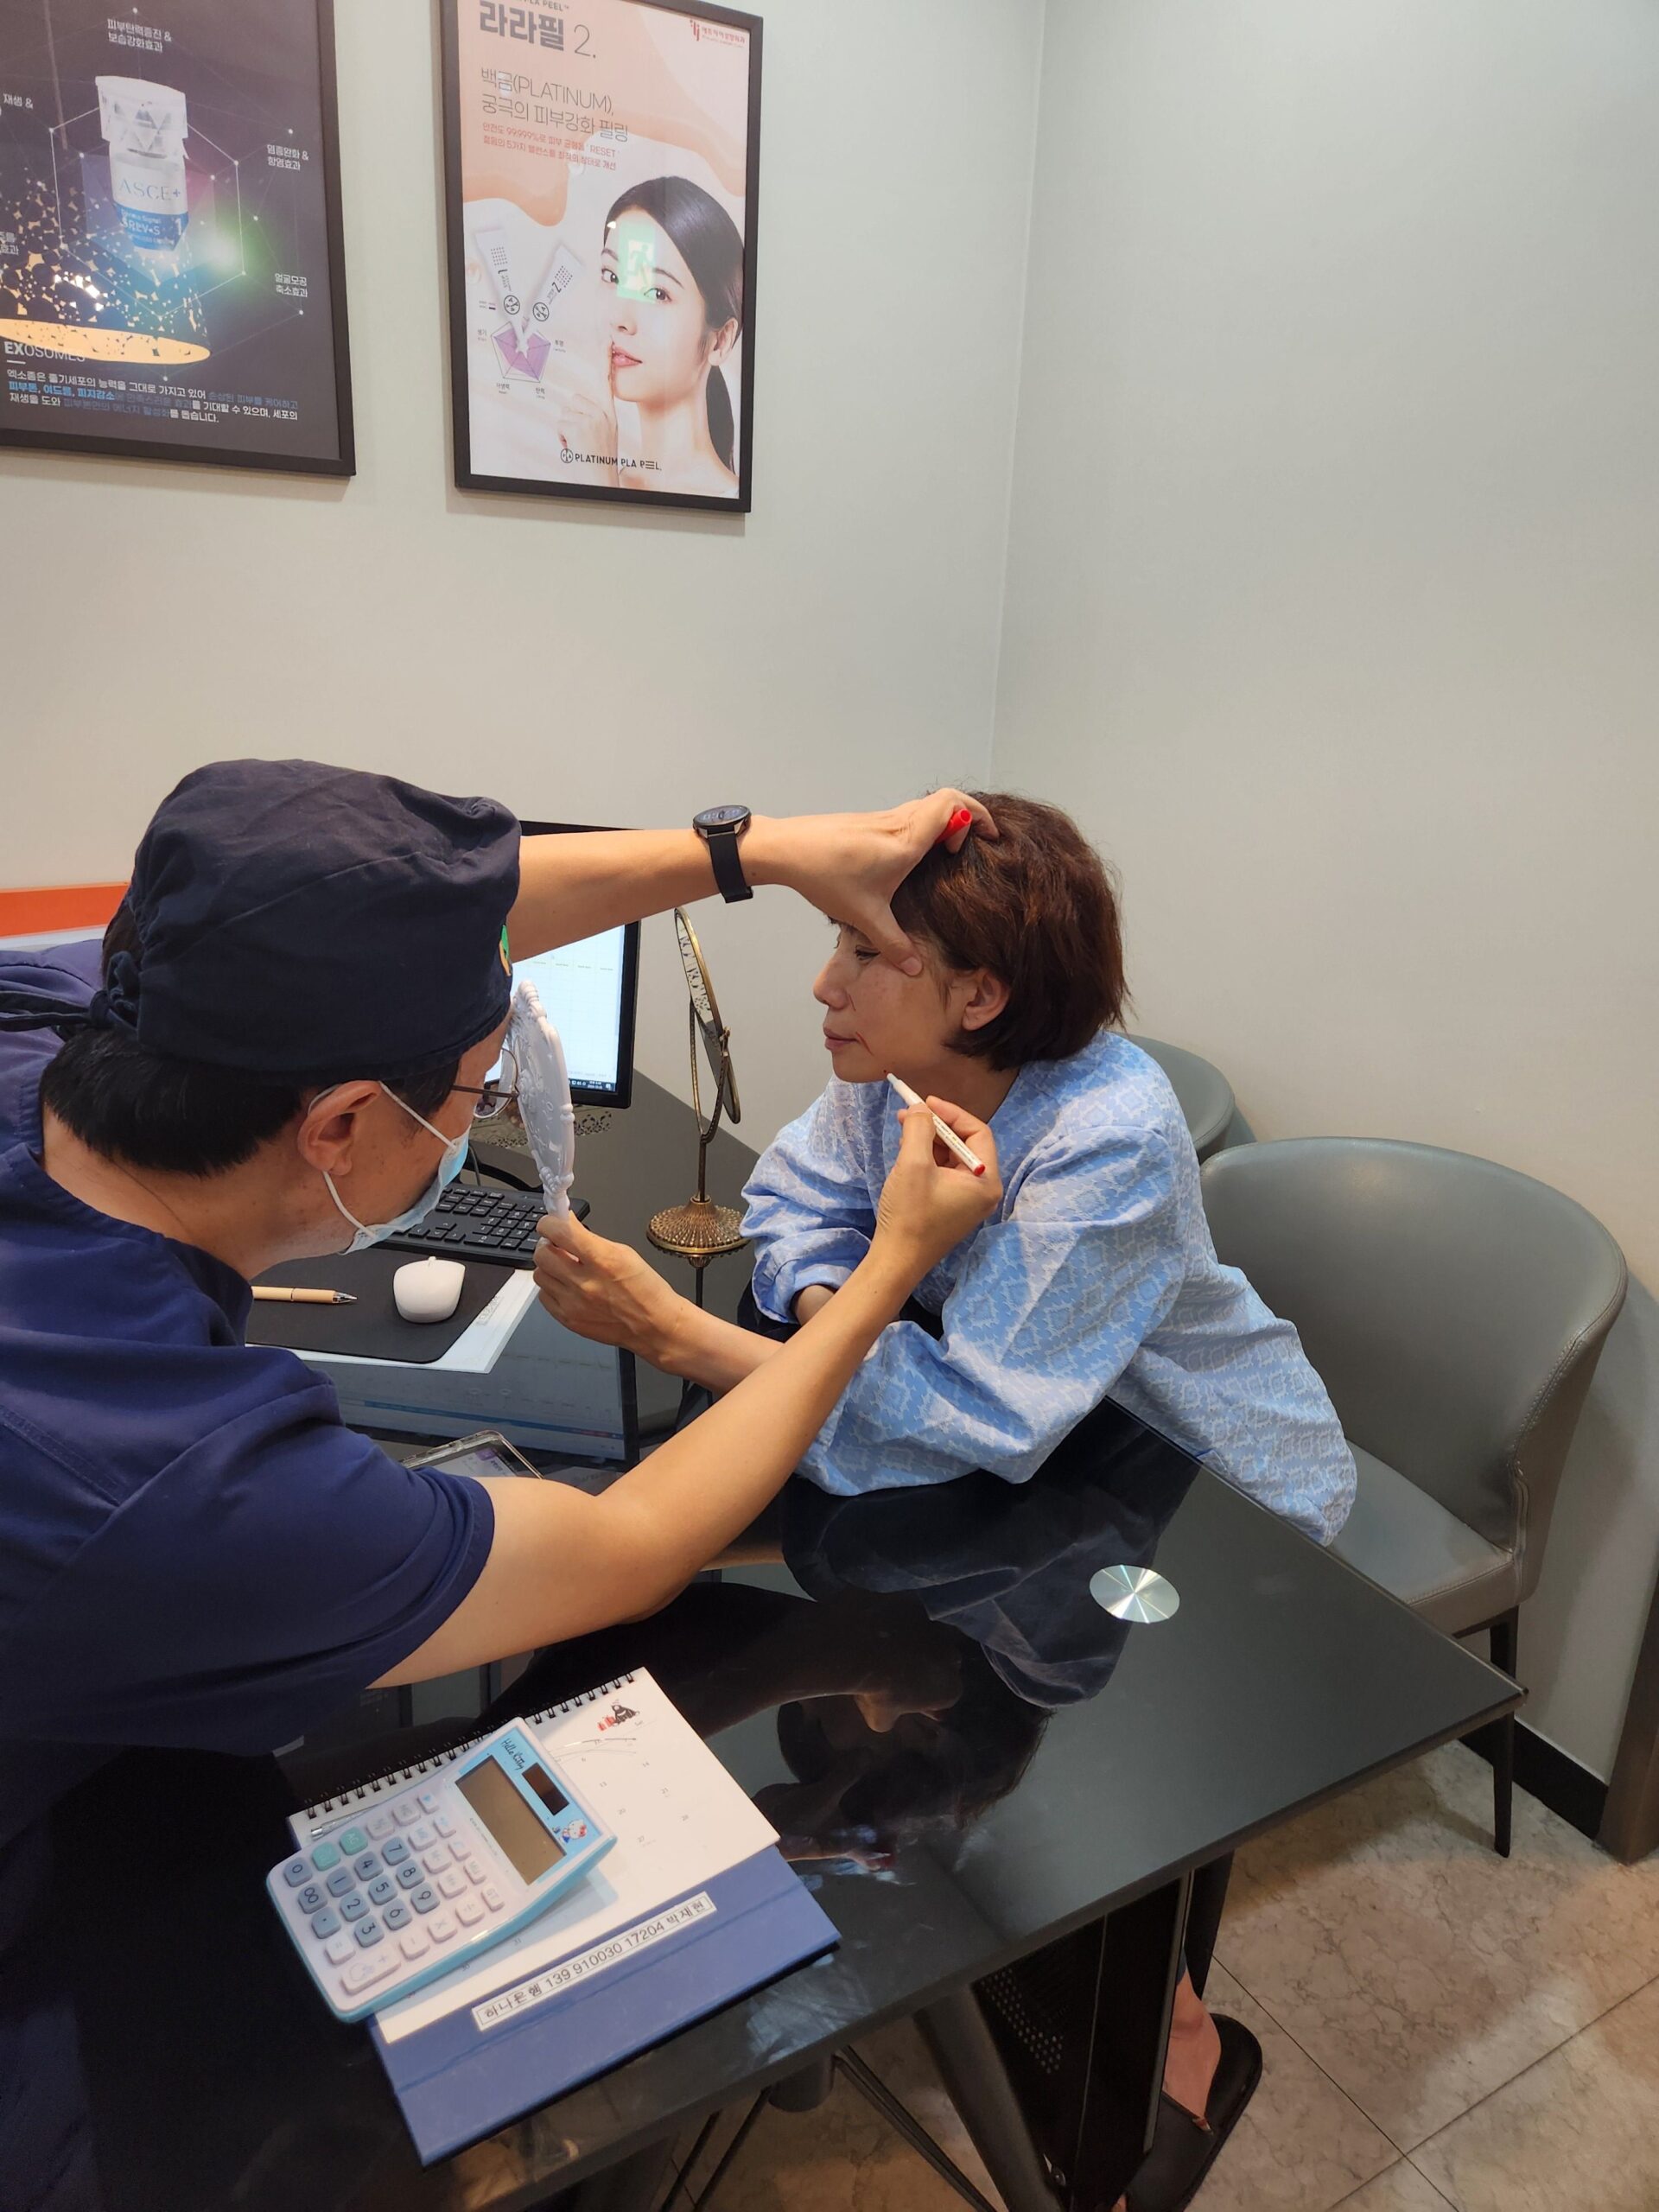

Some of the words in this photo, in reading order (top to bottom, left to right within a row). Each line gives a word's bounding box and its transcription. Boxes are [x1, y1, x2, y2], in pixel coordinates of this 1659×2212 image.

[164, 31, 172, 41] &
[480, 0, 564, 51] 라라필
[574, 24, 596, 59] 2.
[25, 97, 34, 110] &
[482, 93, 530, 121] 궁극의
[533, 104, 594, 135] 피부강화
[600, 119, 628, 143] 필링
[302, 150, 309, 161] &
[590, 144, 616, 158] RESET
[121, 177, 181, 200] ASCE+
[129, 381, 156, 394] 그대로
[158, 385, 186, 397] 가지고
[188, 388, 207, 399] 있어
[41, 396, 60, 407] 도와
[232, 404, 241, 415] 수
[575, 453, 619, 467] PLATINUM
[620, 458, 637, 468] PLA
[545, 1968, 572, 1988] 139
[573, 1942, 624, 1975] 910030
[625, 1921, 665, 1948] 17204
[666, 1900, 708, 1928] 박재현
